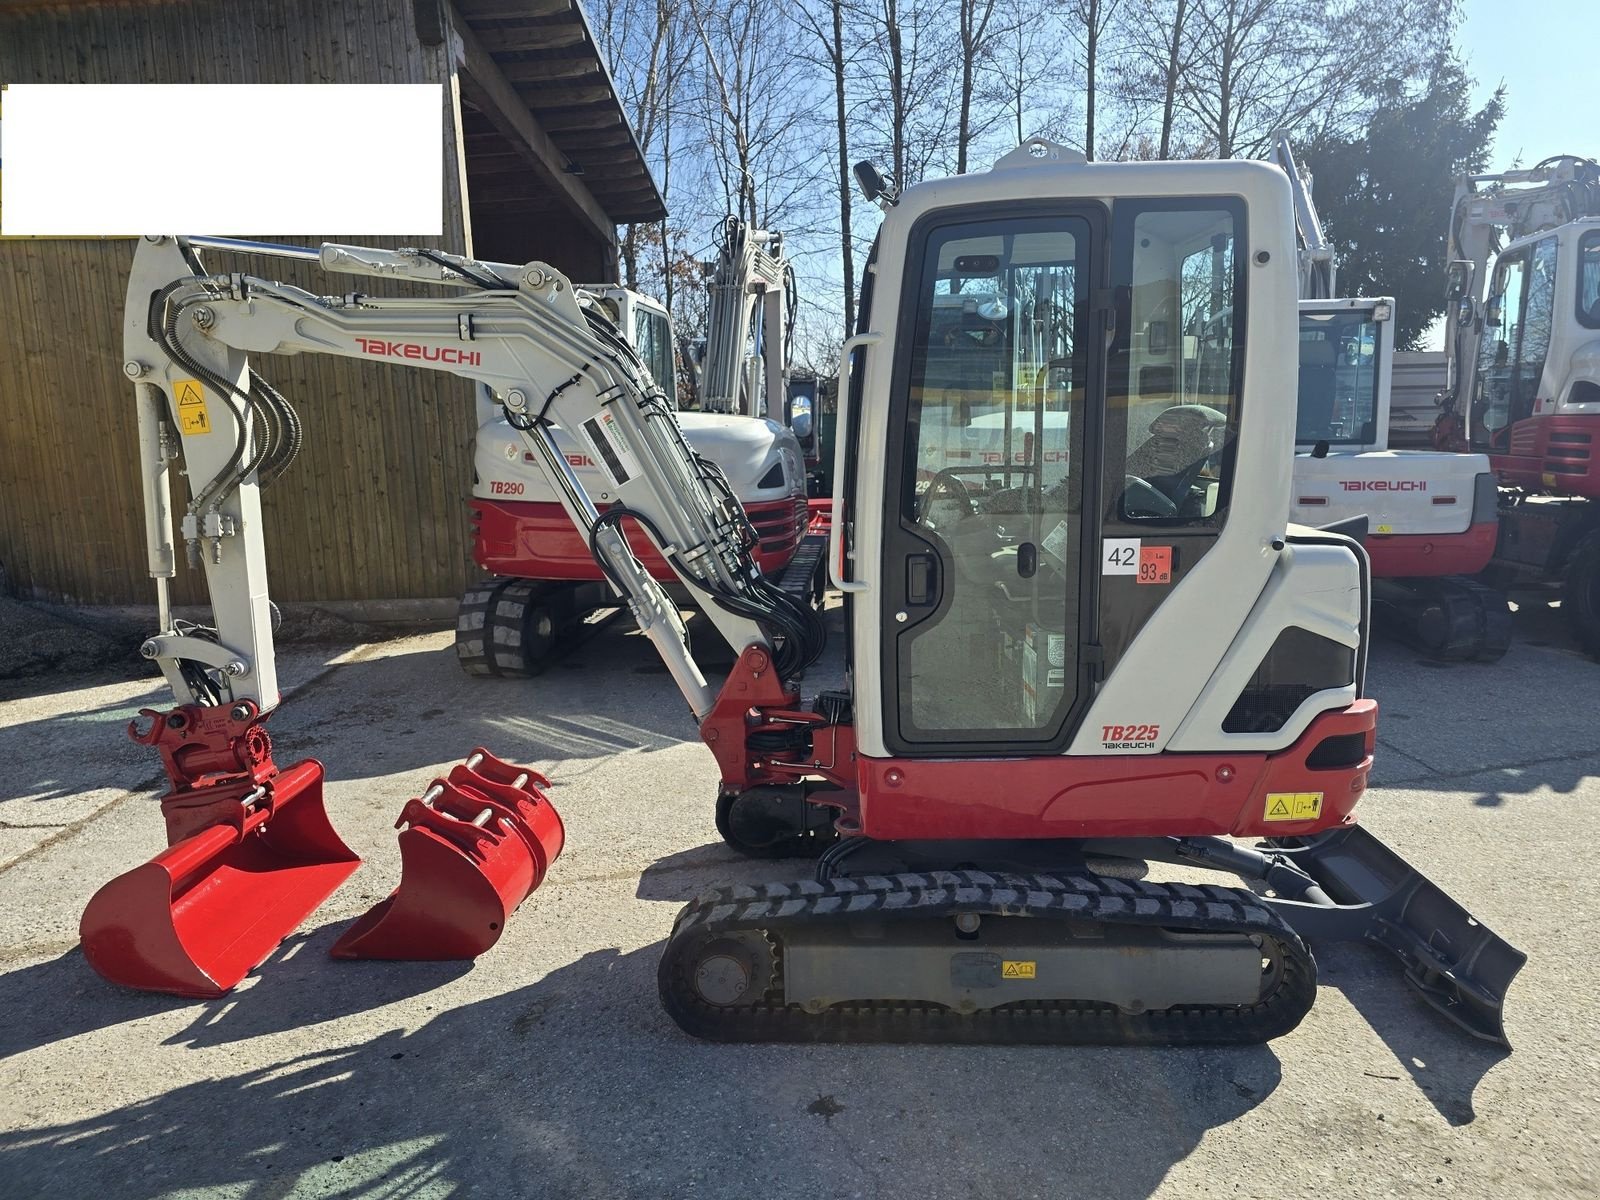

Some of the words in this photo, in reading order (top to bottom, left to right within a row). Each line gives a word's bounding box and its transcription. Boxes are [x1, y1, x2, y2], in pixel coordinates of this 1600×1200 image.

[355, 338, 481, 366] TAKEUCHI
[490, 481, 525, 495] TB290
[1339, 480, 1427, 491] TAKEUCHI
[1107, 547, 1136, 566] 42
[1140, 562, 1157, 581] 93
[1159, 572, 1168, 580] dB
[1102, 725, 1160, 741] TB225
